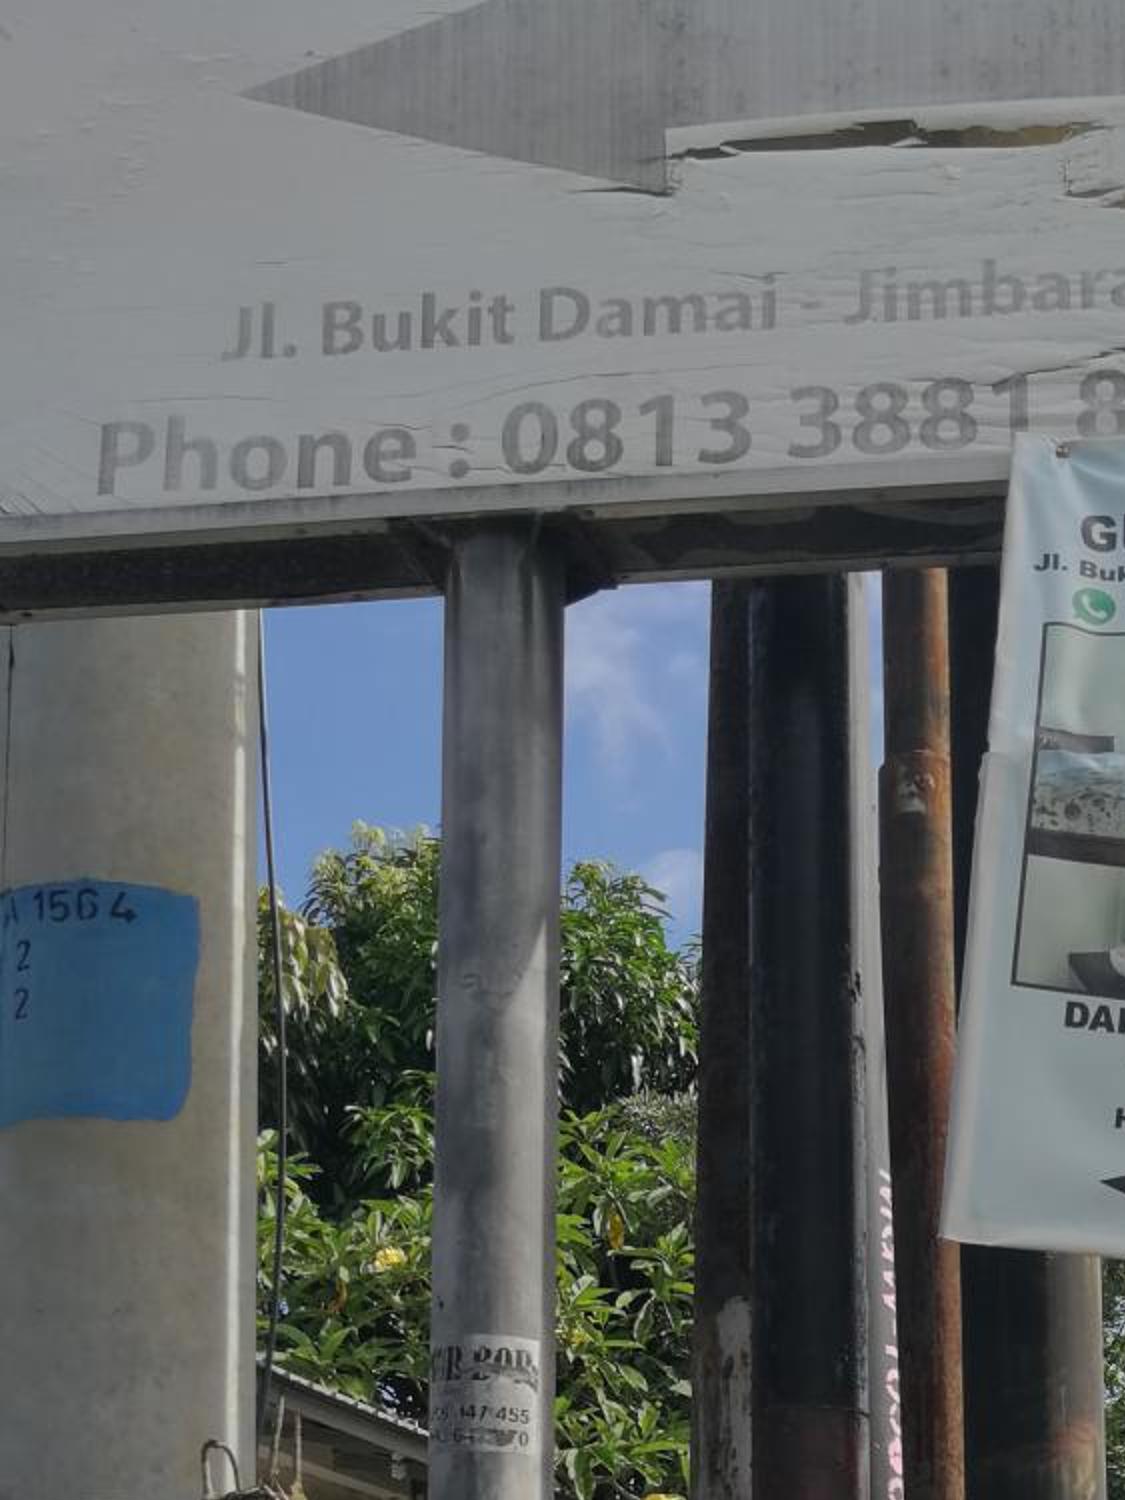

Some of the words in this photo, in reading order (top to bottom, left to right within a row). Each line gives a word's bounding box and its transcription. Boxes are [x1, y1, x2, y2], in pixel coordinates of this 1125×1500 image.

[220, 301, 297, 362] Jl.
[321, 289, 516, 356] Bukit
[539, 274, 777, 342] Damai
[97, 415, 418, 497] Phone
[501, 390, 753, 475] 0813
[787, 373, 1030, 459] 3881
[1033, 553, 1068, 572] Jl.
[16, 940, 31, 973] 2
[15, 988, 30, 1021] 2
